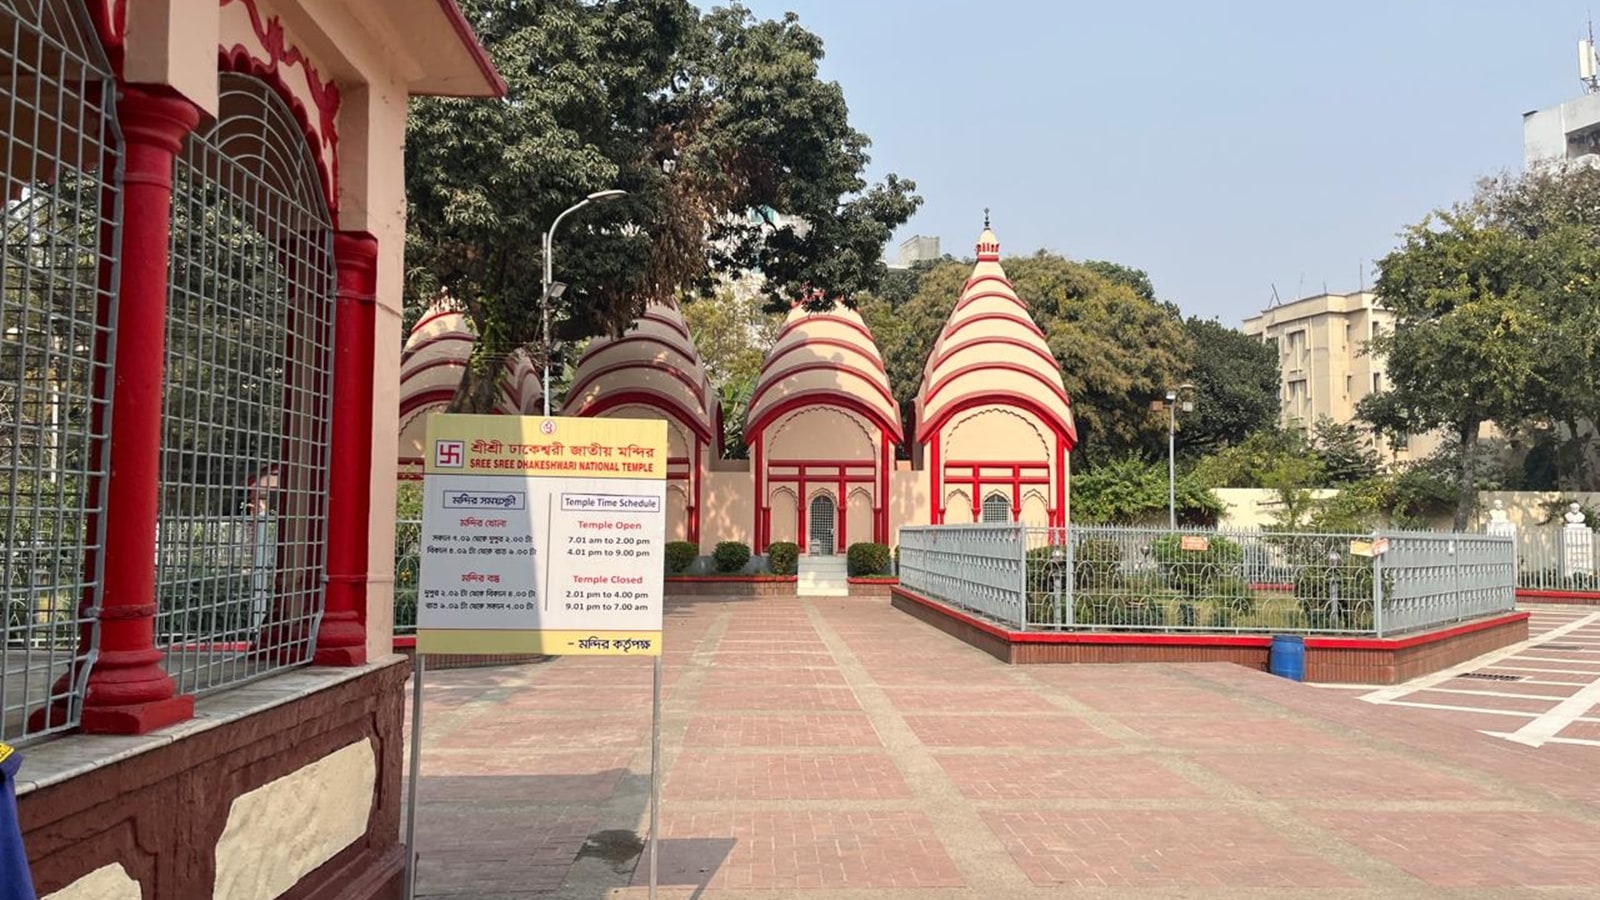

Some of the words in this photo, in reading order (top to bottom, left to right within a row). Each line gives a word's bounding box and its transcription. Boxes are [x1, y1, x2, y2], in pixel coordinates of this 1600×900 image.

[471, 439, 503, 454] শ্রীশ্রী
[508, 441, 565, 456] ঢাকেশ্বরী
[569, 442, 614, 457] জাতীয়
[617, 443, 655, 458] মন্দির
[470, 459, 492, 468] SREE
[494, 459, 515, 469] SREE
[517, 459, 577, 471] DHAKESHWARI
[579, 461, 619, 472] NATIONAL
[622, 462, 654, 472] TEMPLE
[452, 493, 478, 505] মন্দির
[565, 497, 595, 507] Temple
[597, 498, 617, 507] Time
[619, 498, 656, 508] Schedule
[460, 516, 483, 527] মন্দির
[578, 520, 613, 530] Temple
[615, 521, 642, 531] Open
[568, 536, 586, 544] 7.01
[604, 537, 614, 545] to
[615, 537, 635, 545] 2.00
[636, 538, 650, 546] pm
[567, 548, 586, 556] 4.01
[588, 549, 602, 557] pm
[615, 549, 634, 557] 9.00
[461, 571, 484, 582] মন্দির
[573, 575, 608, 585] Temple
[610, 575, 643, 584] Closed
[566, 590, 584, 598] 2.01
[586, 591, 601, 599] pm
[634, 592, 649, 600] pm
[614, 603, 633, 611] 7.00
[578, 635, 610, 650] মন্দির
[612, 637, 652, 653] কর্তৃপক্ষ
